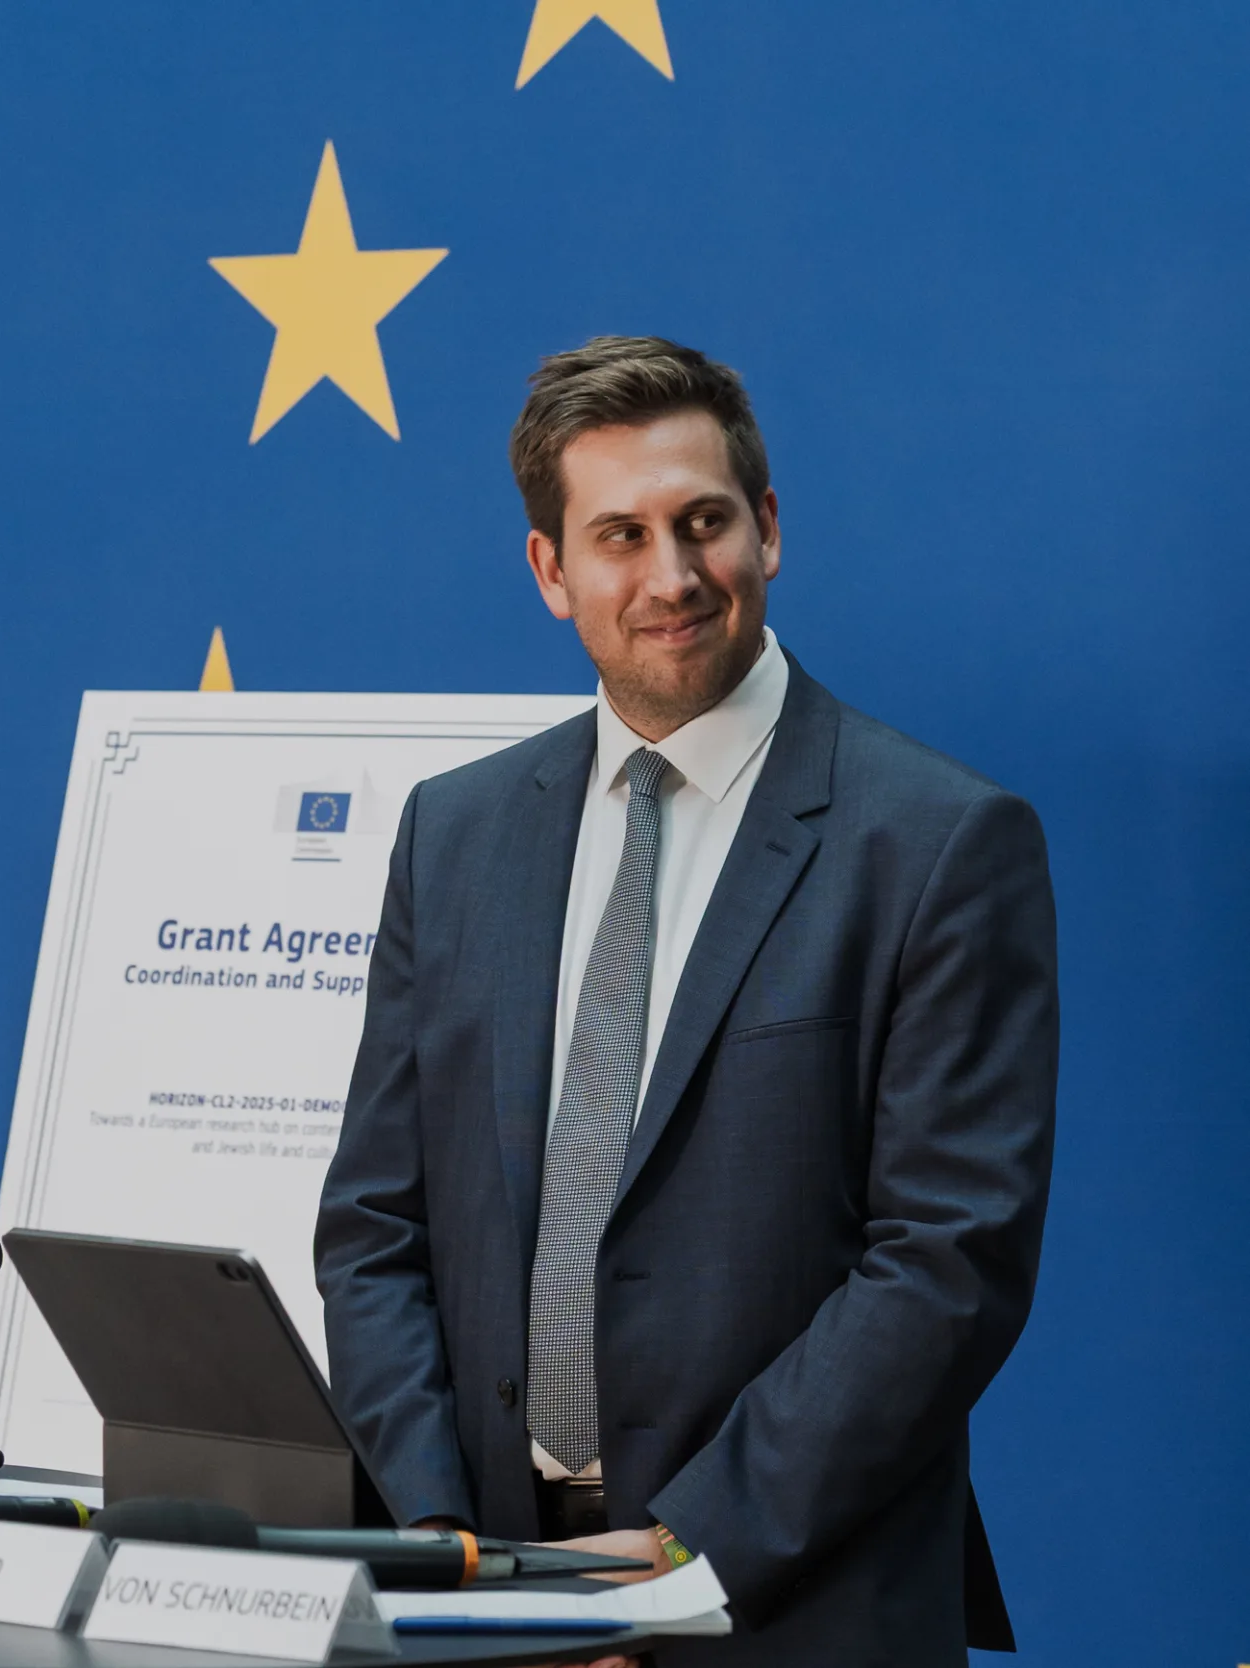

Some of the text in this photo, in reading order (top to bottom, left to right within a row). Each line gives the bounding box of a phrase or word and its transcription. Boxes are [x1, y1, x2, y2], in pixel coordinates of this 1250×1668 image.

[158, 919, 250, 951] Grant
[124, 964, 257, 988] Coordination
[266, 969, 305, 989] and
[90, 1111, 134, 1127] Towards
[138, 1116, 145, 1127] a
[149, 1113, 203, 1131] European
[104, 1574, 161, 1606] VON
[165, 1580, 338, 1622] SCHNURBEIN
